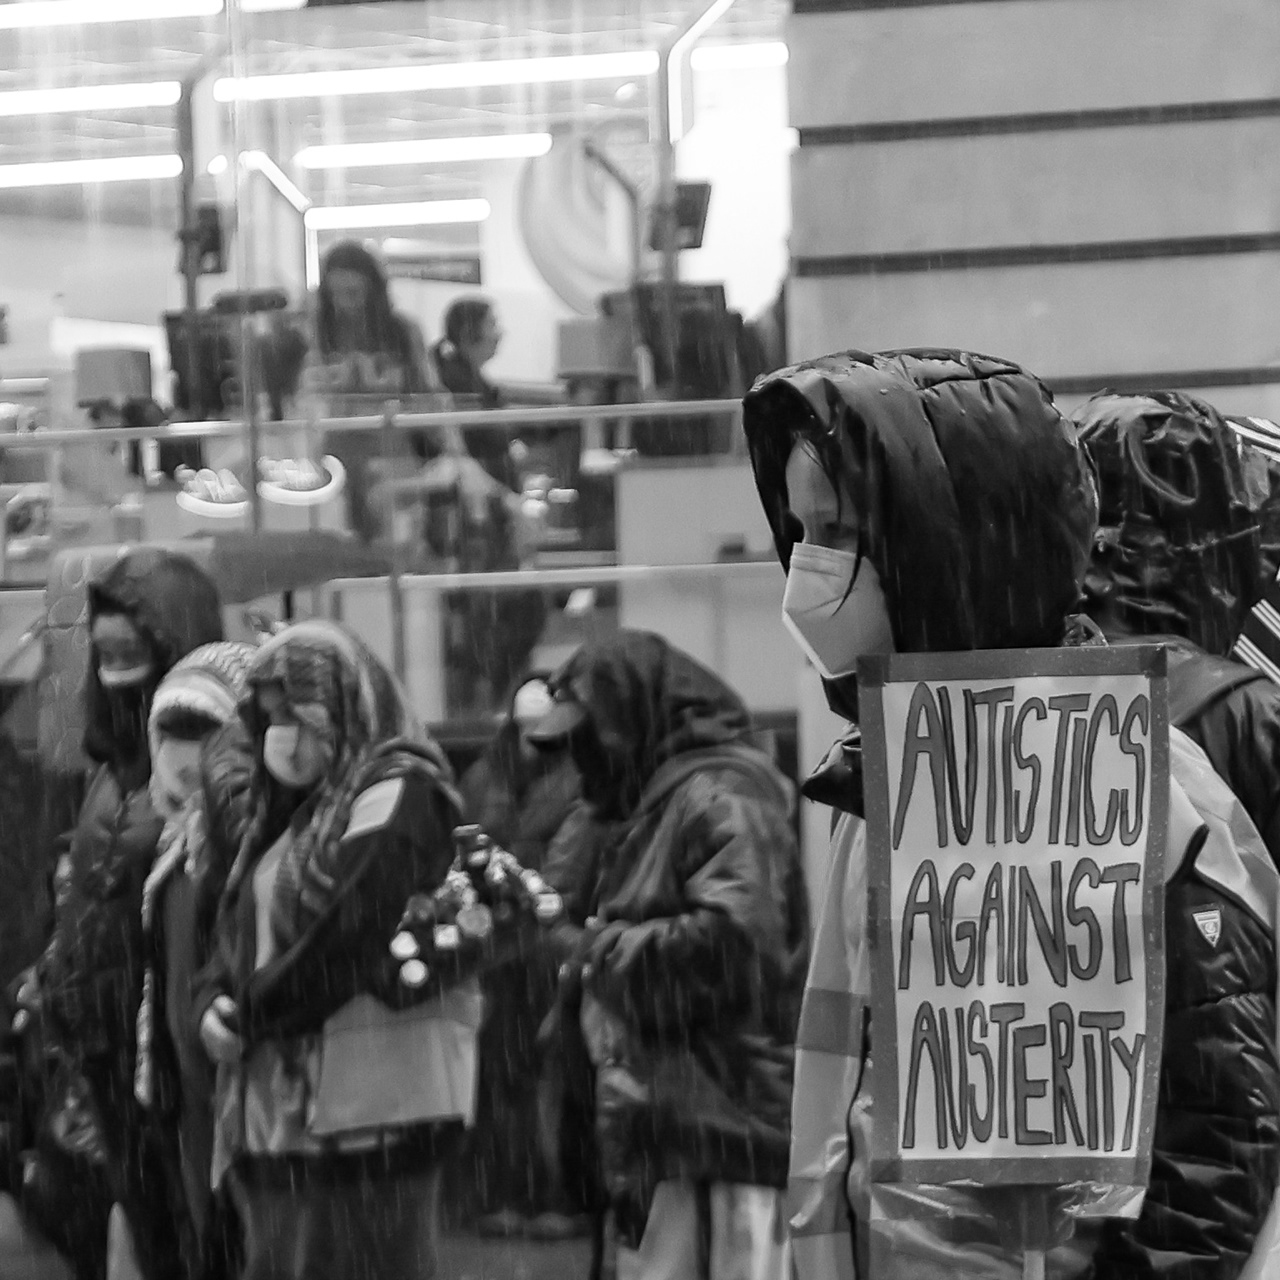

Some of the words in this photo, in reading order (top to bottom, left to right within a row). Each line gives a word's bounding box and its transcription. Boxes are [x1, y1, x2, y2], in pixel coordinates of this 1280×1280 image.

[893, 681, 1149, 850] AUTISTICS
[898, 857, 1141, 991] AGAINST
[902, 1000, 1147, 1152] AUSTERITY
